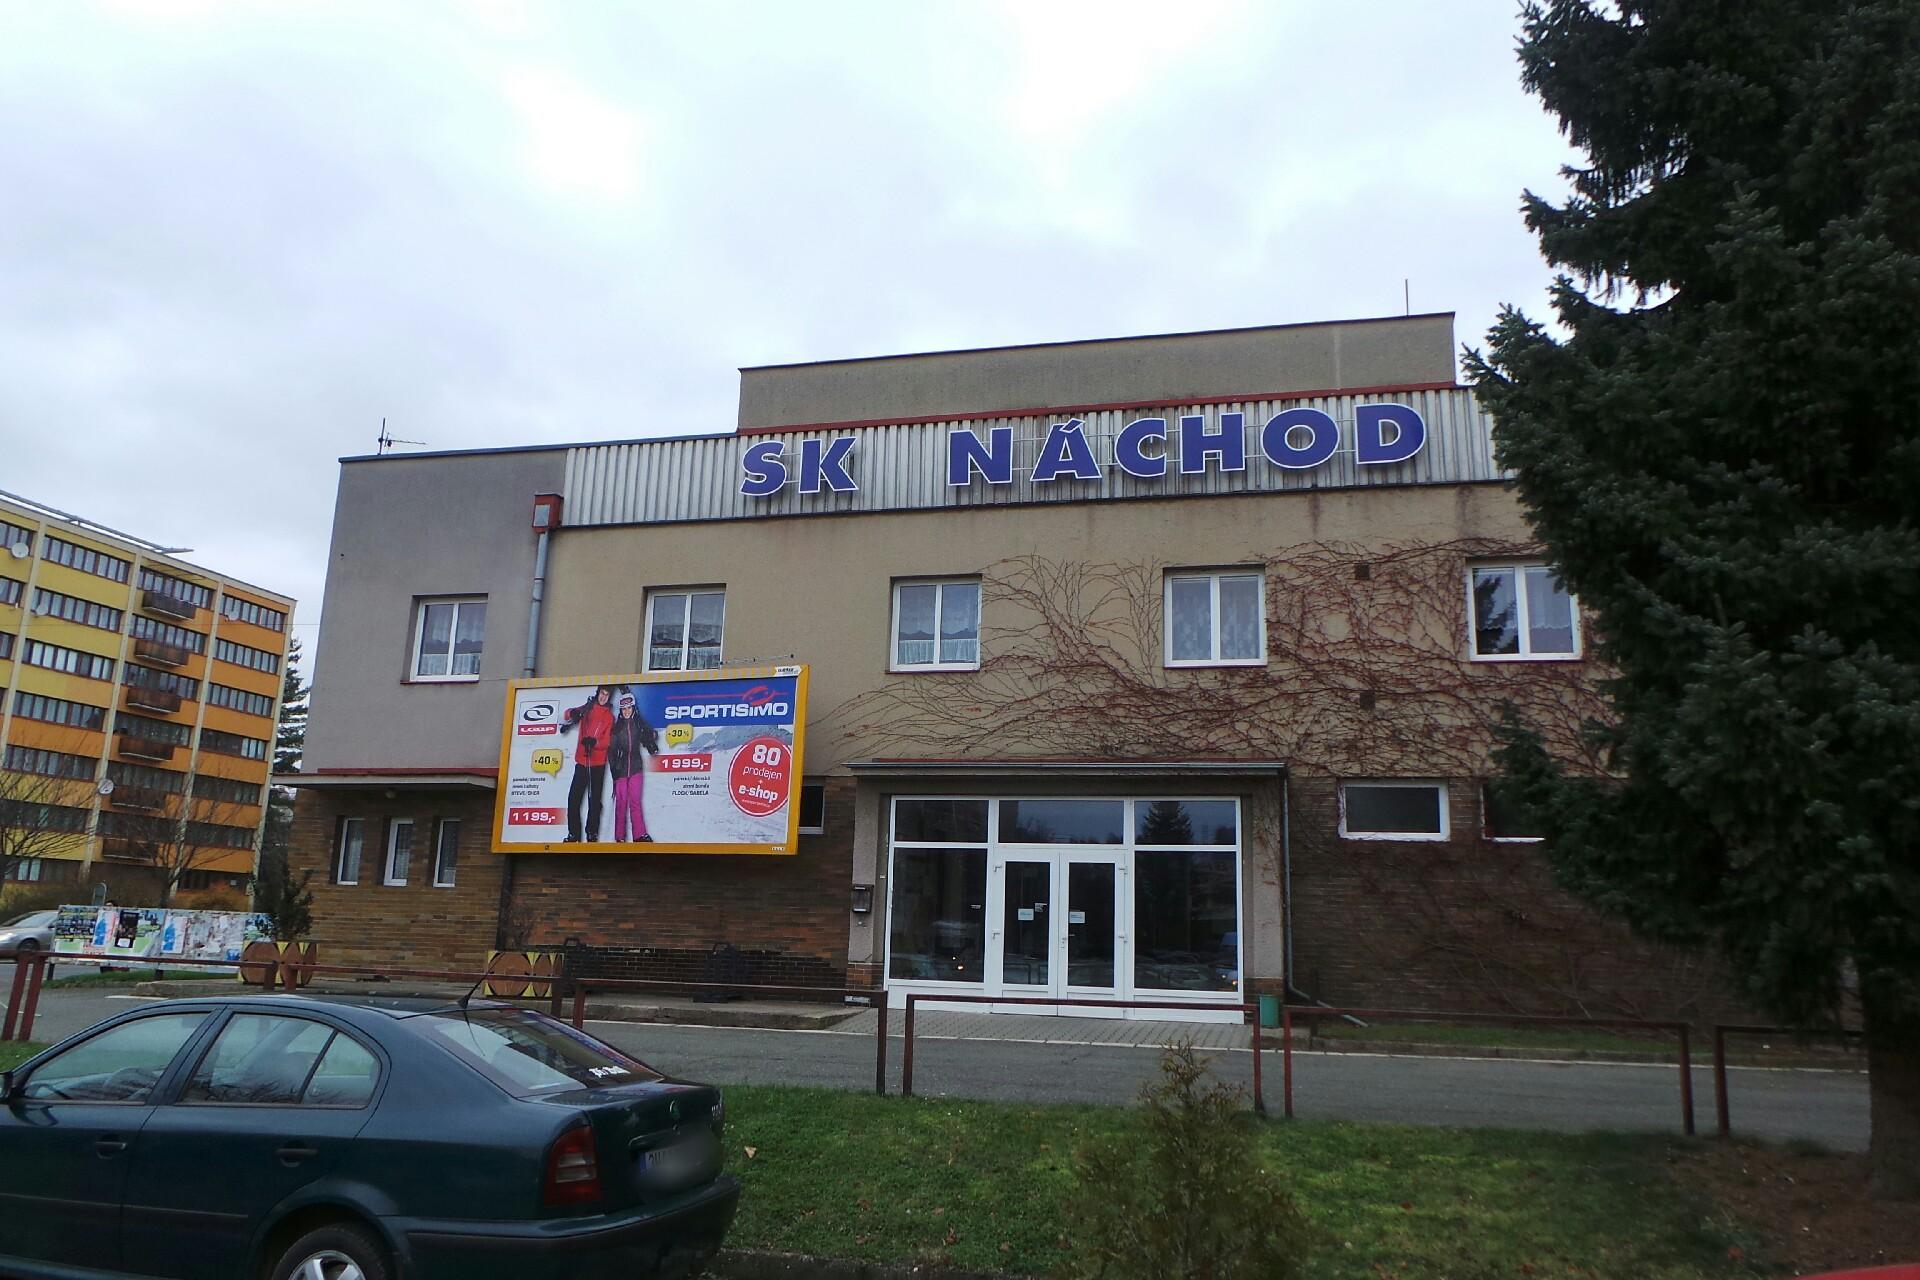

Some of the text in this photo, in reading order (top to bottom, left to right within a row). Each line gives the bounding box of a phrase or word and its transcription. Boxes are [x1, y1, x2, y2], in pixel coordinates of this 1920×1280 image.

[740, 402, 1426, 496] SK NÁCHOD
[752, 744, 782, 766] 80
[742, 766, 783, 781] prodejen
[738, 784, 779, 804] e-shop
